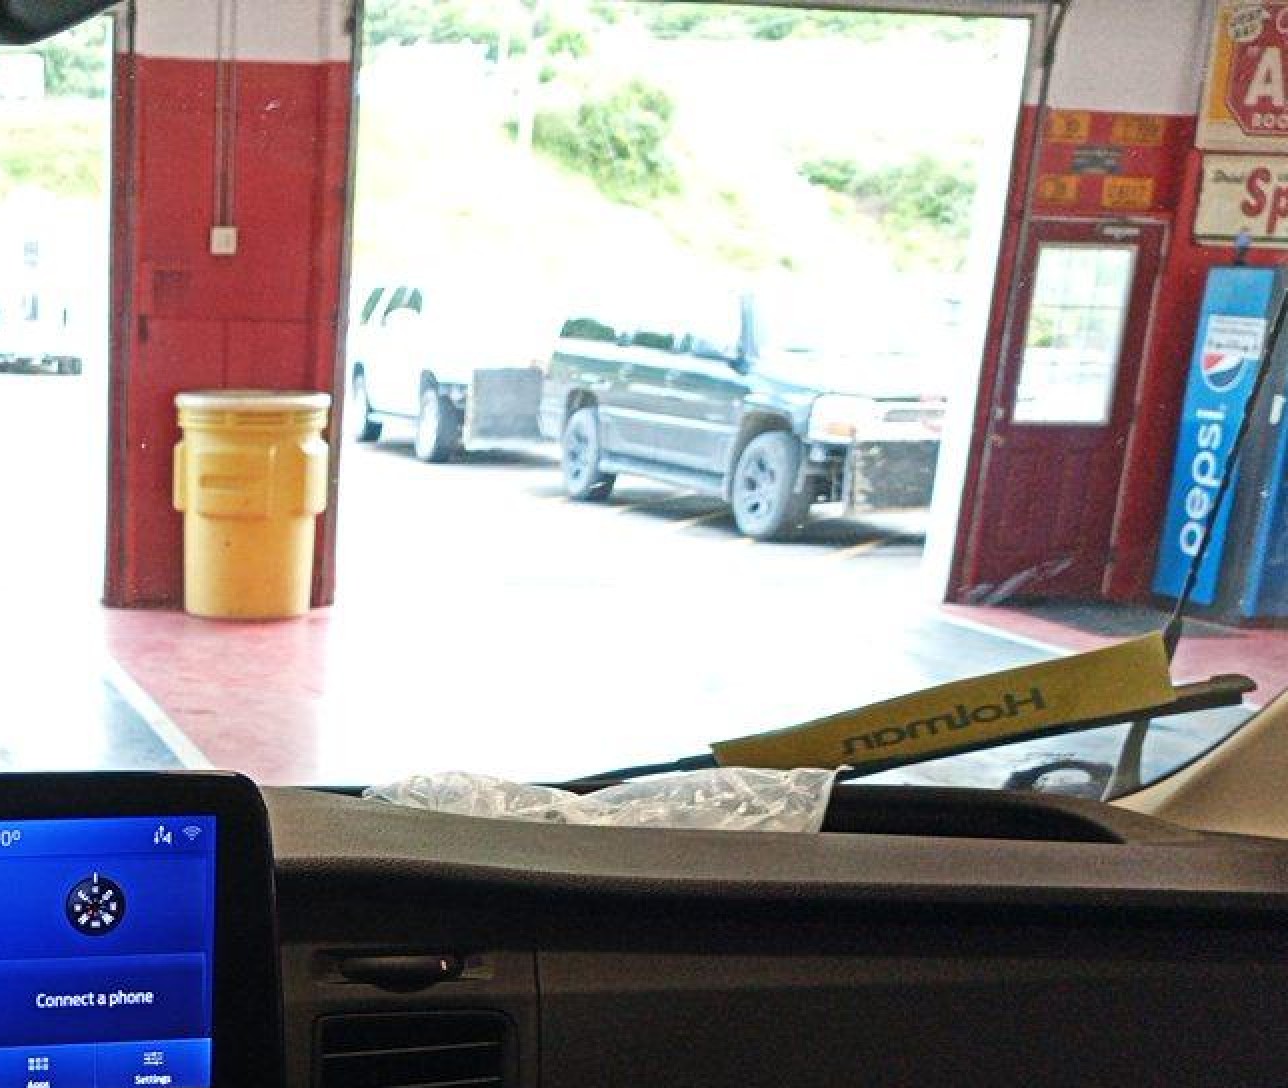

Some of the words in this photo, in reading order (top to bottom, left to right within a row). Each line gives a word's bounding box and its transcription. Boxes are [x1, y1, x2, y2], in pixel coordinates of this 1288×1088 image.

[1179, 408, 1226, 558] pepsi
[35, 991, 95, 1008] Connect
[97, 994, 107, 1005] a
[109, 989, 154, 1008] phone
[133, 1073, 173, 1086] Settings
